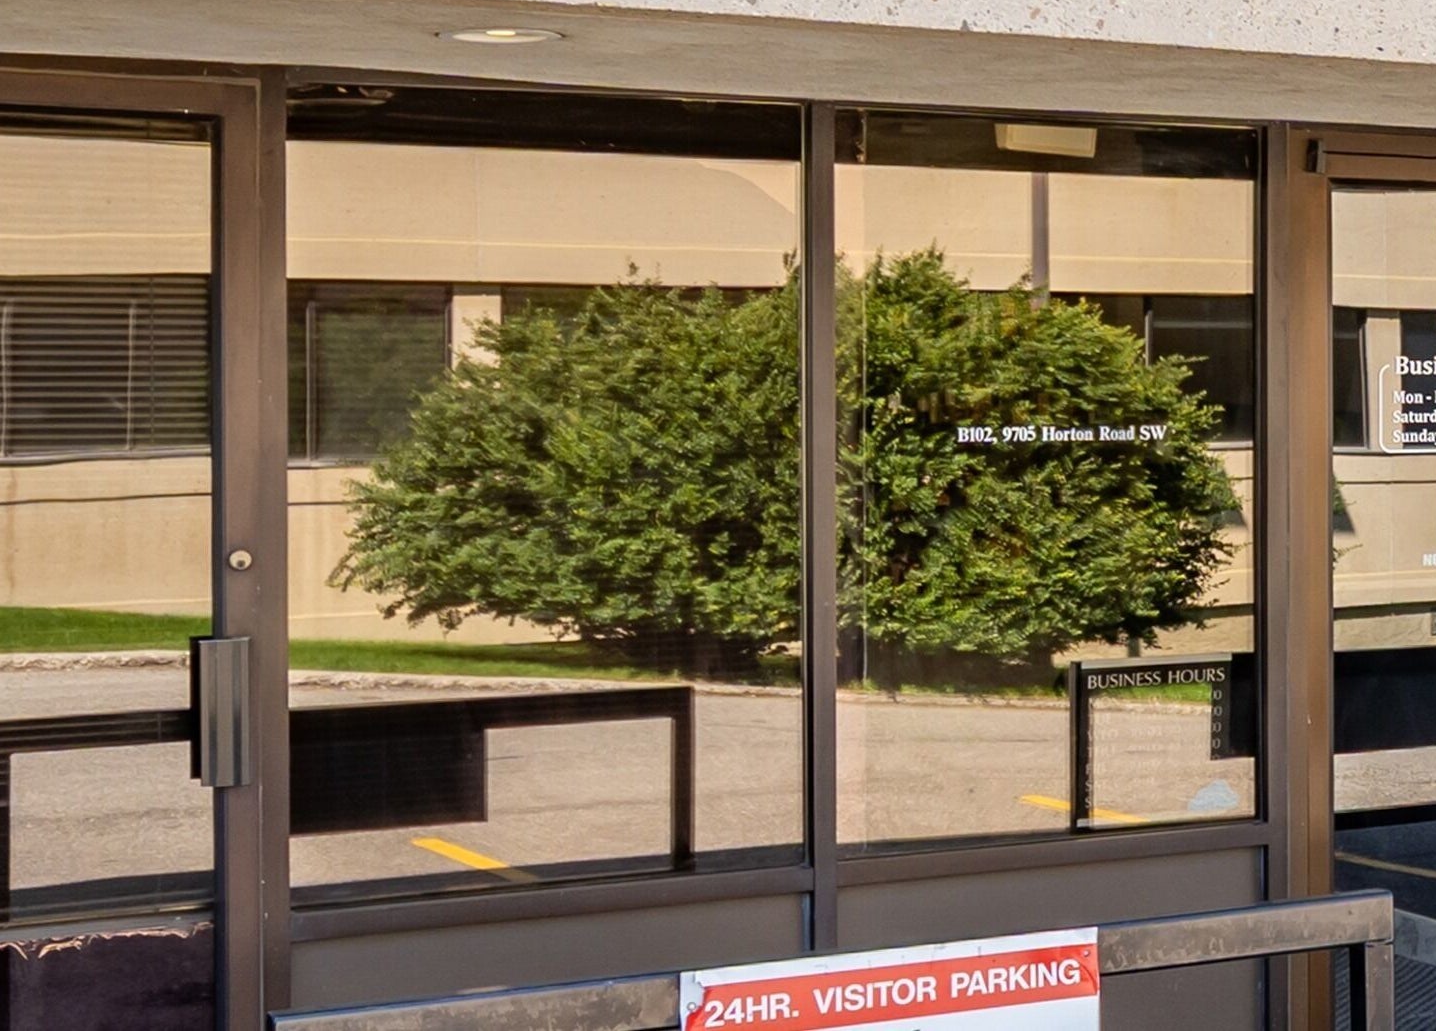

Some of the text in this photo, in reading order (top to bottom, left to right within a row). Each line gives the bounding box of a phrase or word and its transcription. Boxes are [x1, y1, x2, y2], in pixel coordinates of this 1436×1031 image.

[1393, 390, 1423, 404] Mon
[957, 424, 1167, 444] B102, 9705 Horton Road SW
[1087, 667, 1226, 690] BUSINESS HOURS
[704, 958, 1082, 1029] 24HR. VISITOR PARKING
